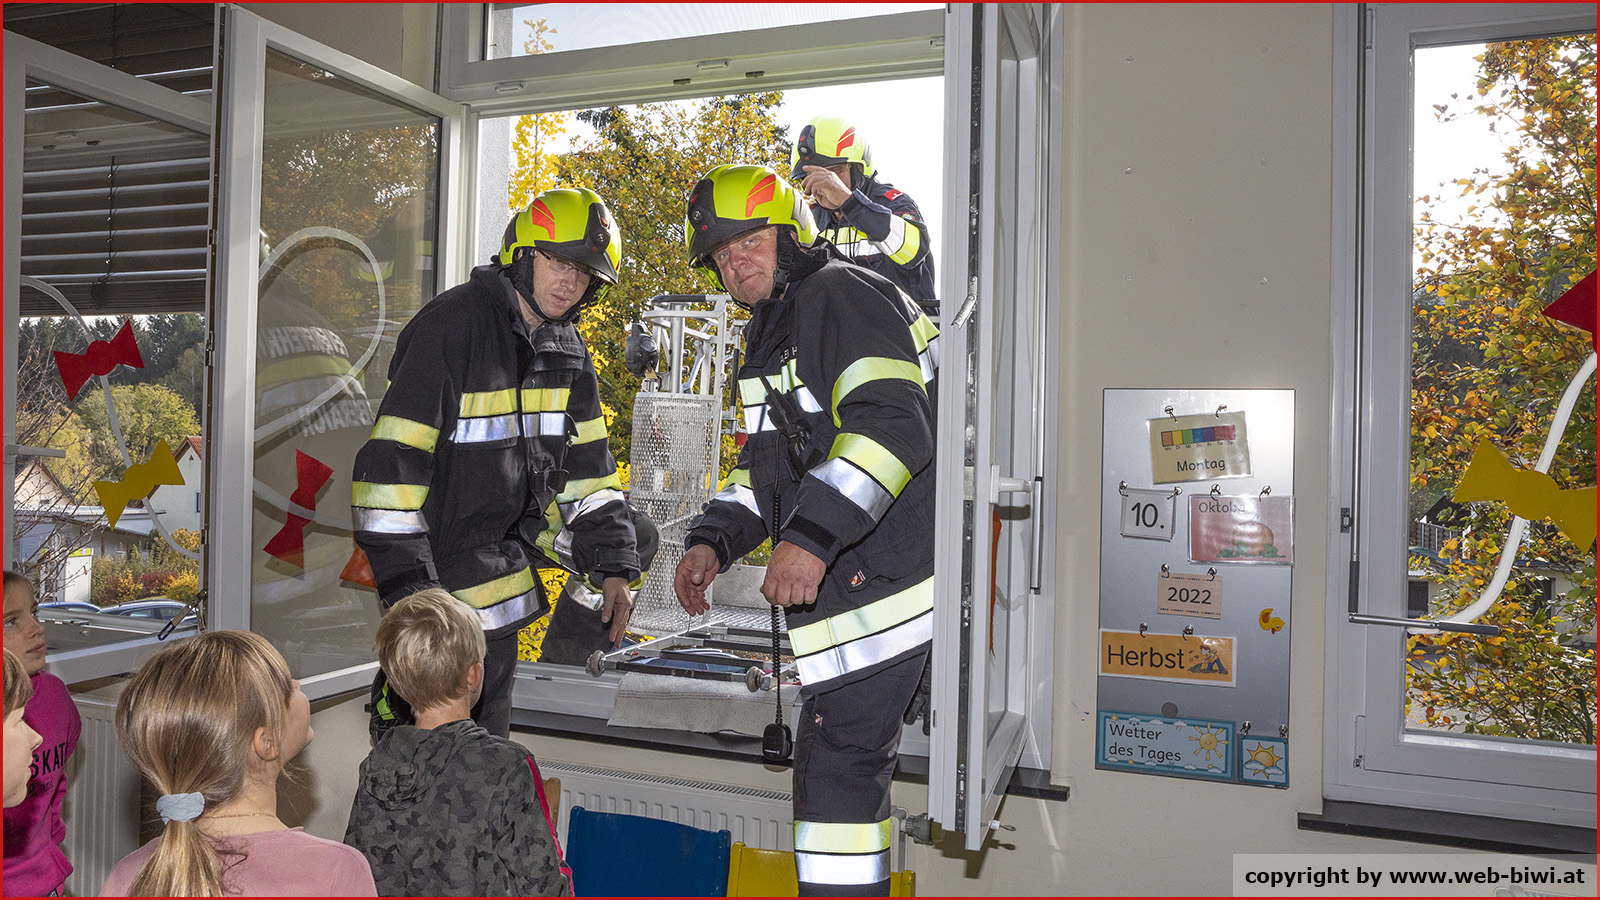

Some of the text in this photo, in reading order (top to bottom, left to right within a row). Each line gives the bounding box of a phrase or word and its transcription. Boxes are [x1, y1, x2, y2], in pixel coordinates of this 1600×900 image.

[1177, 459, 1226, 472] Montag
[1131, 502, 1165, 529] 10.
[1167, 586, 1212, 605] 2022
[1107, 644, 1185, 669] Herbst
[1109, 723, 1162, 741] Wetter
[30, 741, 68, 779] SKAT
[1109, 742, 1182, 763] des Tages
